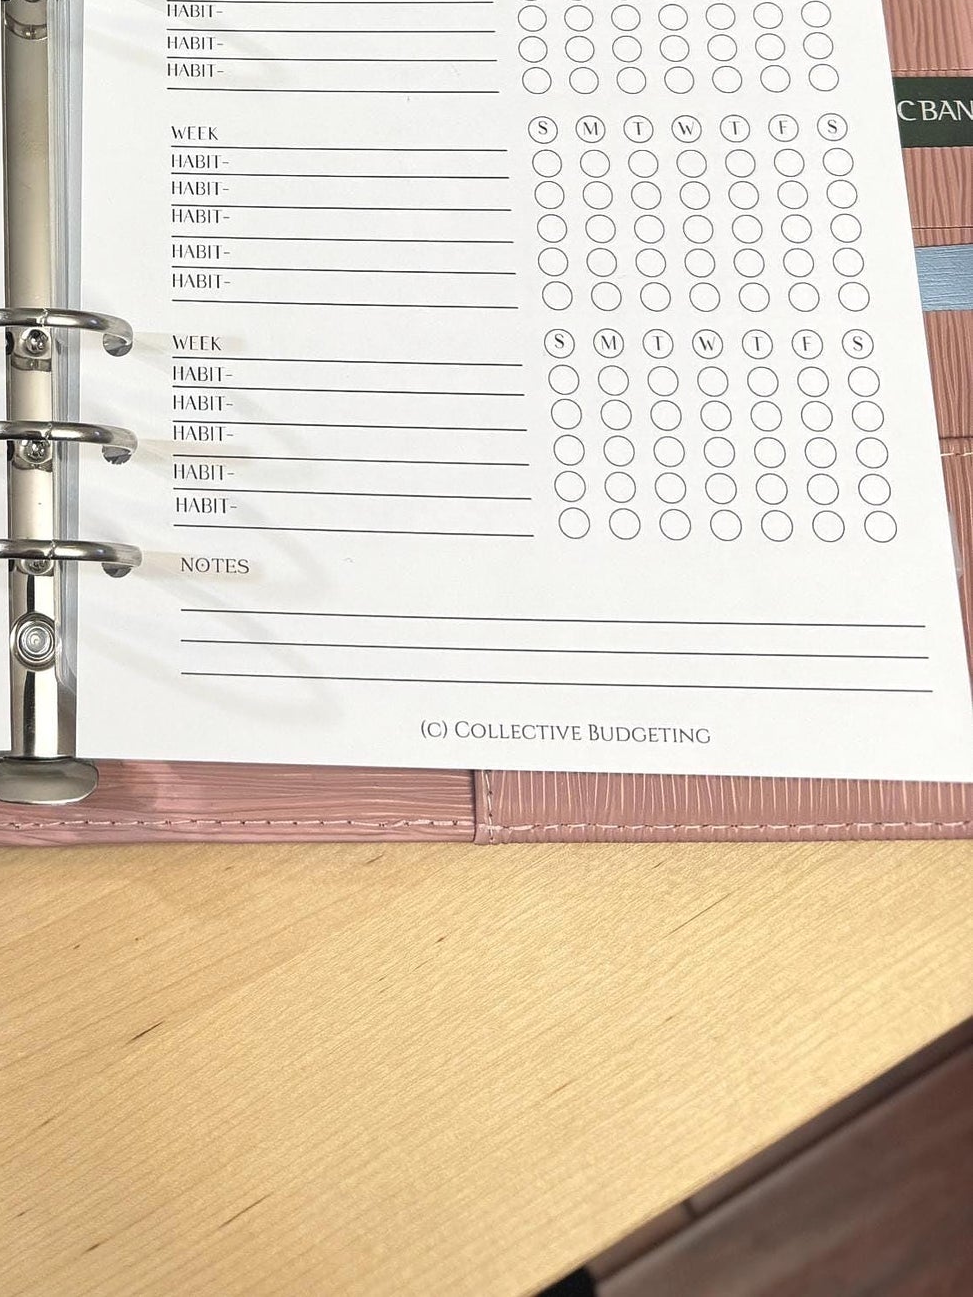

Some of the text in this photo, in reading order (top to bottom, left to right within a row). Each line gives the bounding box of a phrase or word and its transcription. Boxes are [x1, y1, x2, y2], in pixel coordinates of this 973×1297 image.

[170, 125, 219, 141] WEEK
[172, 334, 222, 352] WEEK
[180, 556, 250, 575] NOTES
[454, 720, 583, 741] COLLECTIVE
[587, 723, 711, 745] BUDGETING
